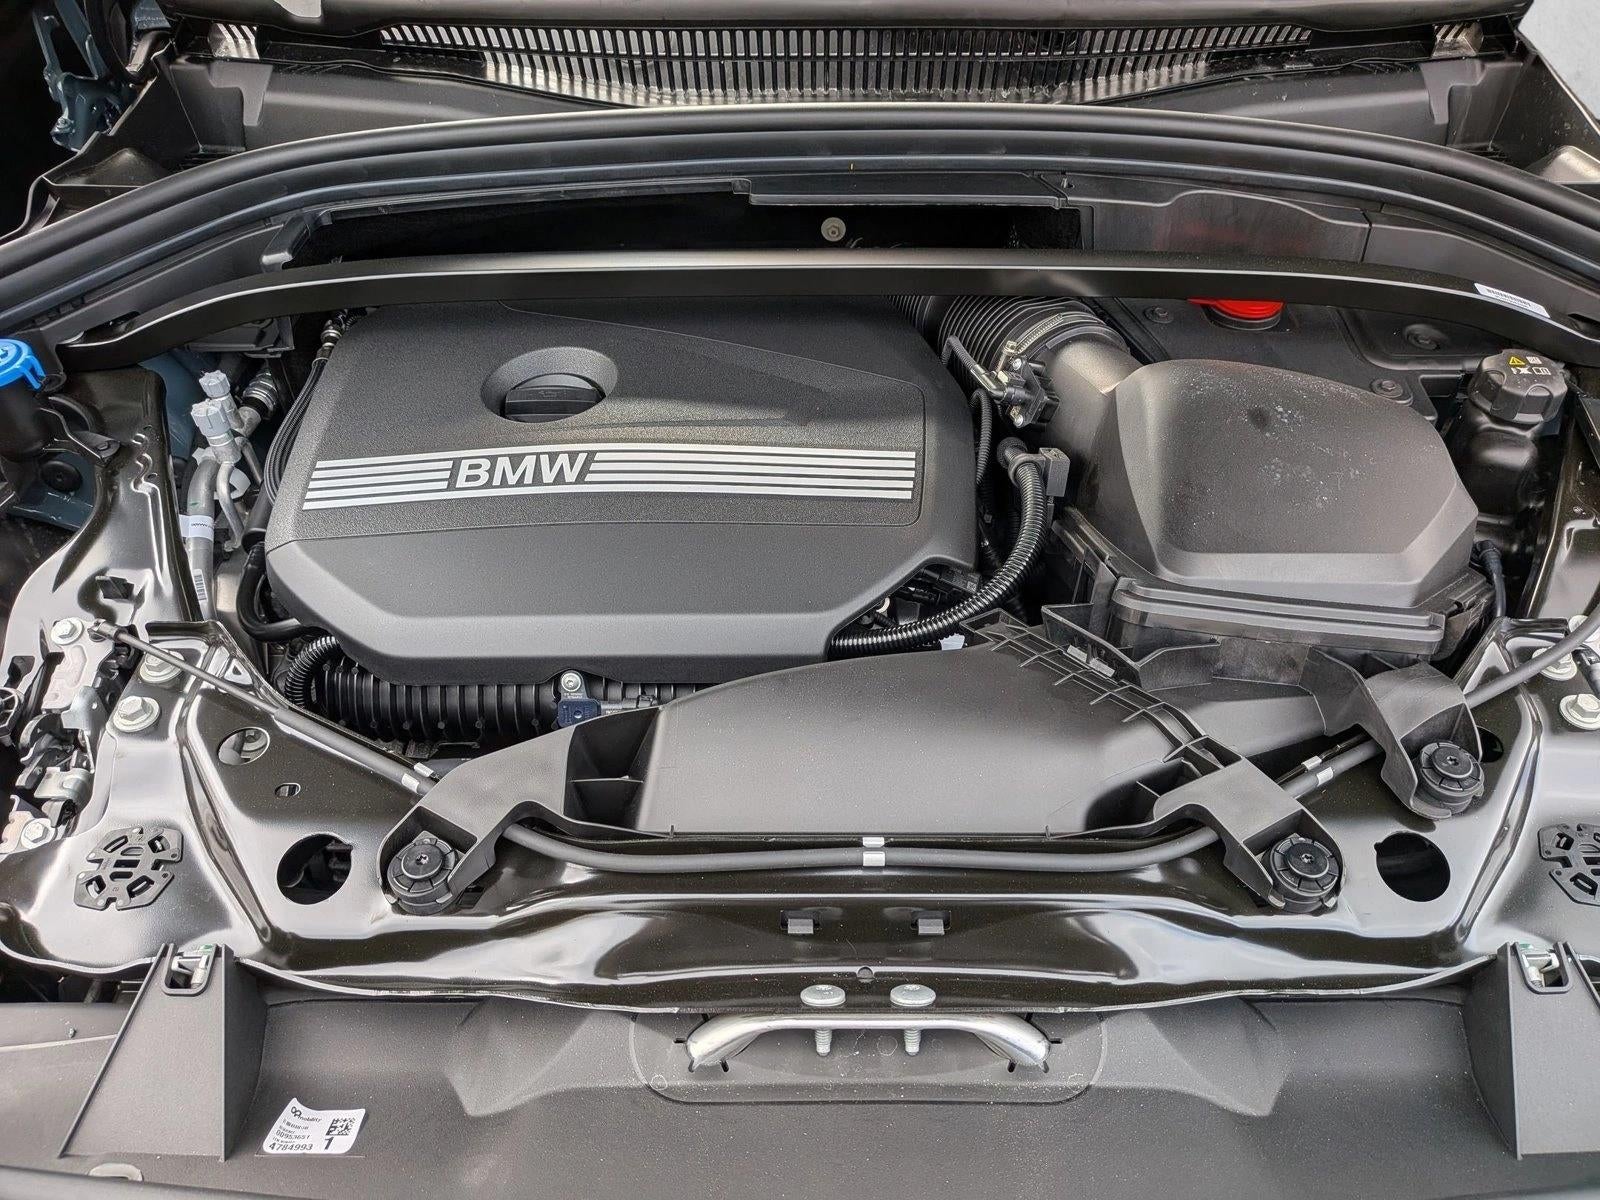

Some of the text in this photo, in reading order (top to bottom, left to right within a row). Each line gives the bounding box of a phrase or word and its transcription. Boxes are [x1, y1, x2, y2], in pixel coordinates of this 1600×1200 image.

[456, 453, 588, 488] BMW
[269, 1142, 313, 1151] 4784993
[324, 1136, 334, 1150] 1
